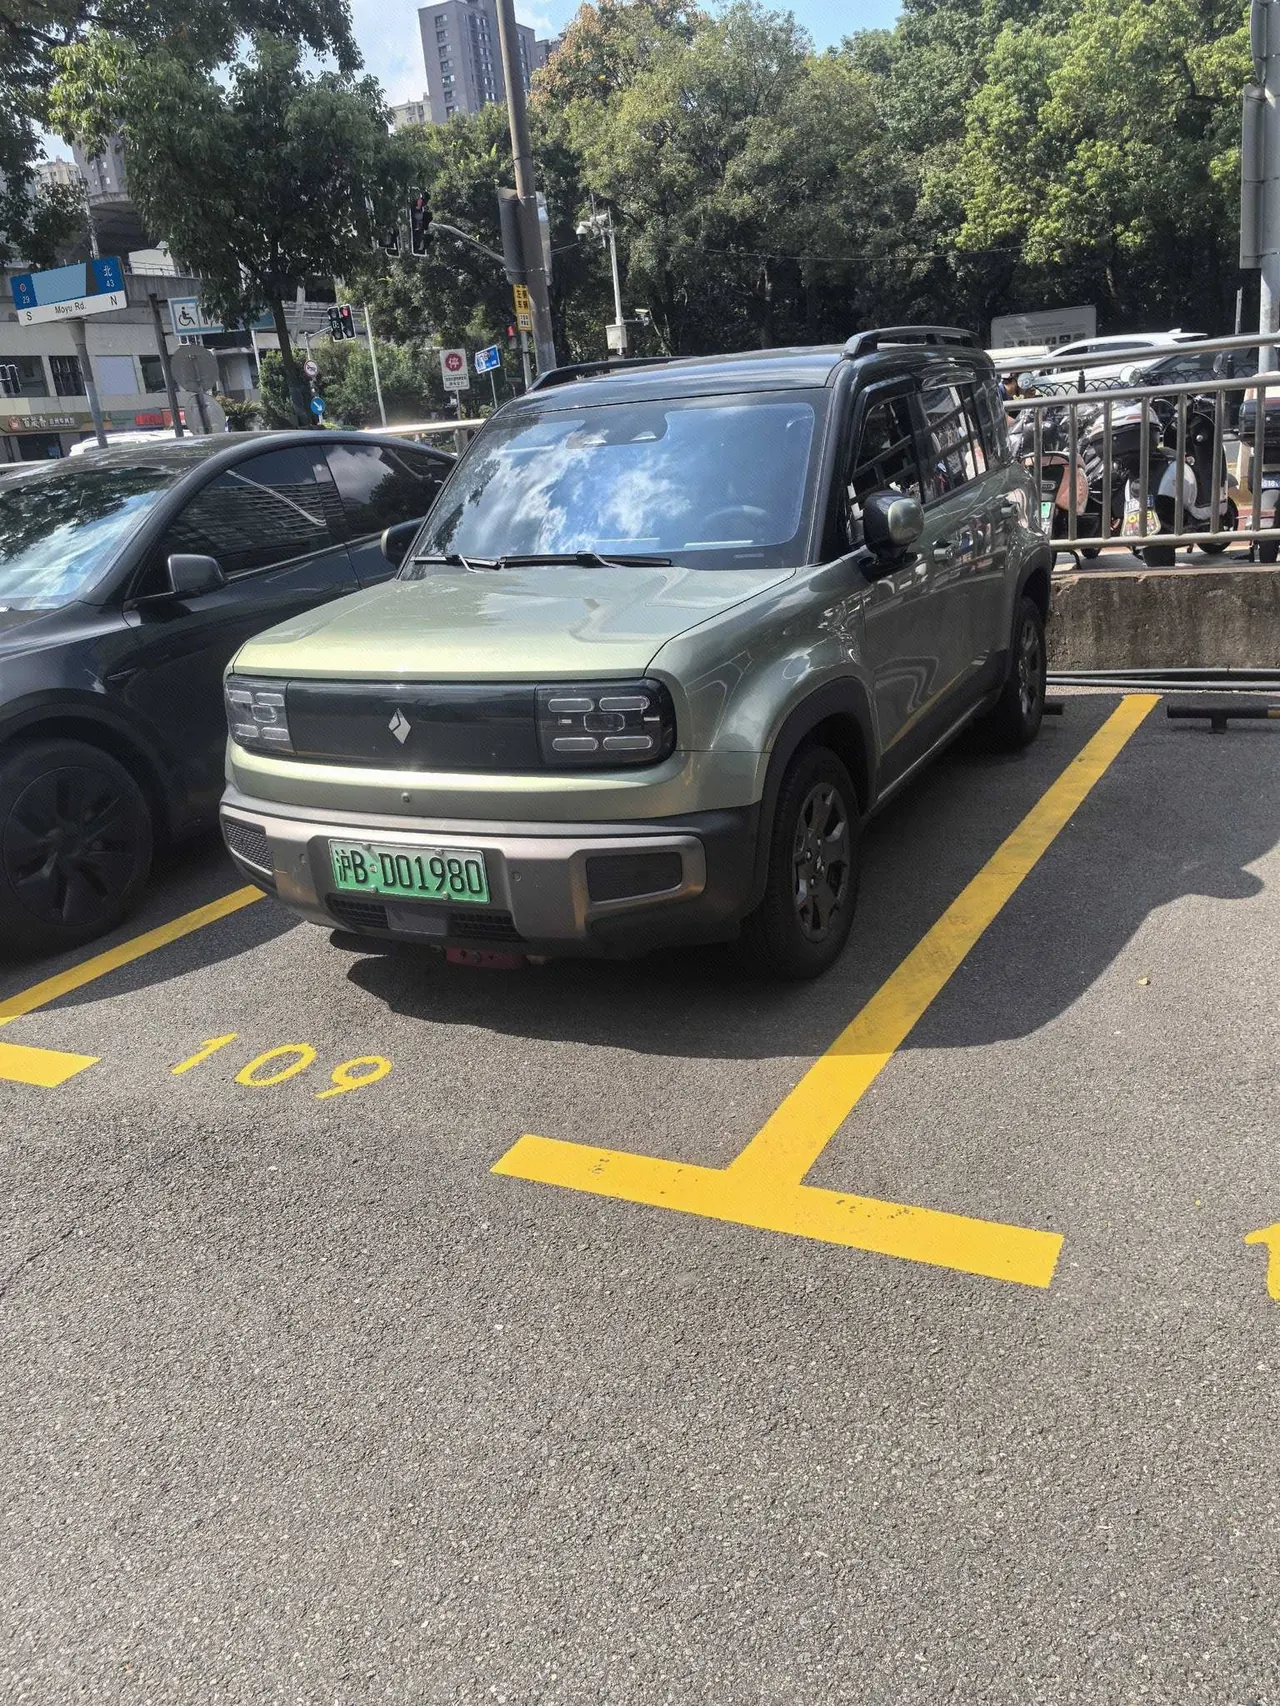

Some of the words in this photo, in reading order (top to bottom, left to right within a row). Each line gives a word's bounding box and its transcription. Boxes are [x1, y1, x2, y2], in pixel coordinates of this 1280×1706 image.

[103, 265, 113, 277] 北
[106, 279, 115, 288] 43
[26, 311, 33, 321] S
[54, 305, 73, 315] Moyu
[74, 301, 87, 310] Rd.
[110, 295, 118, 306] N
[171, 1032, 393, 1100] 109
